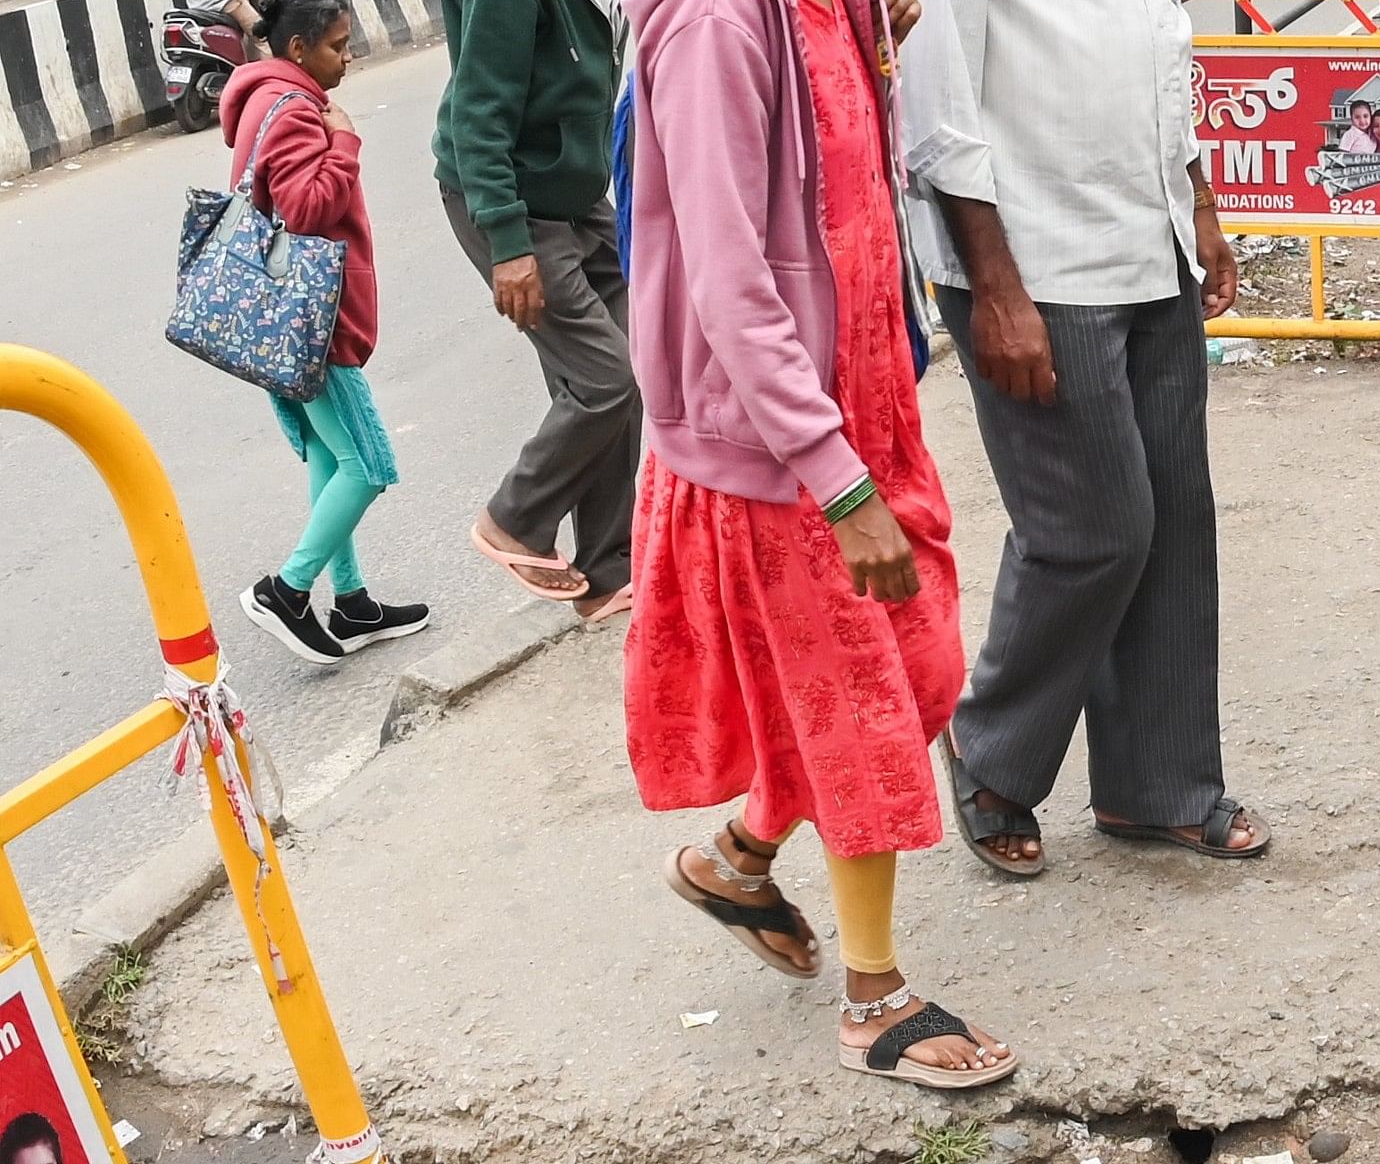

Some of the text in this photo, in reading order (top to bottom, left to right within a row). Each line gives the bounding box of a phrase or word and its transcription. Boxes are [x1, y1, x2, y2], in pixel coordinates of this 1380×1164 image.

[1199, 140, 1296, 184] TMT
[1214, 194, 1294, 209] NDATIONS
[1329, 199, 1376, 215] 9242
